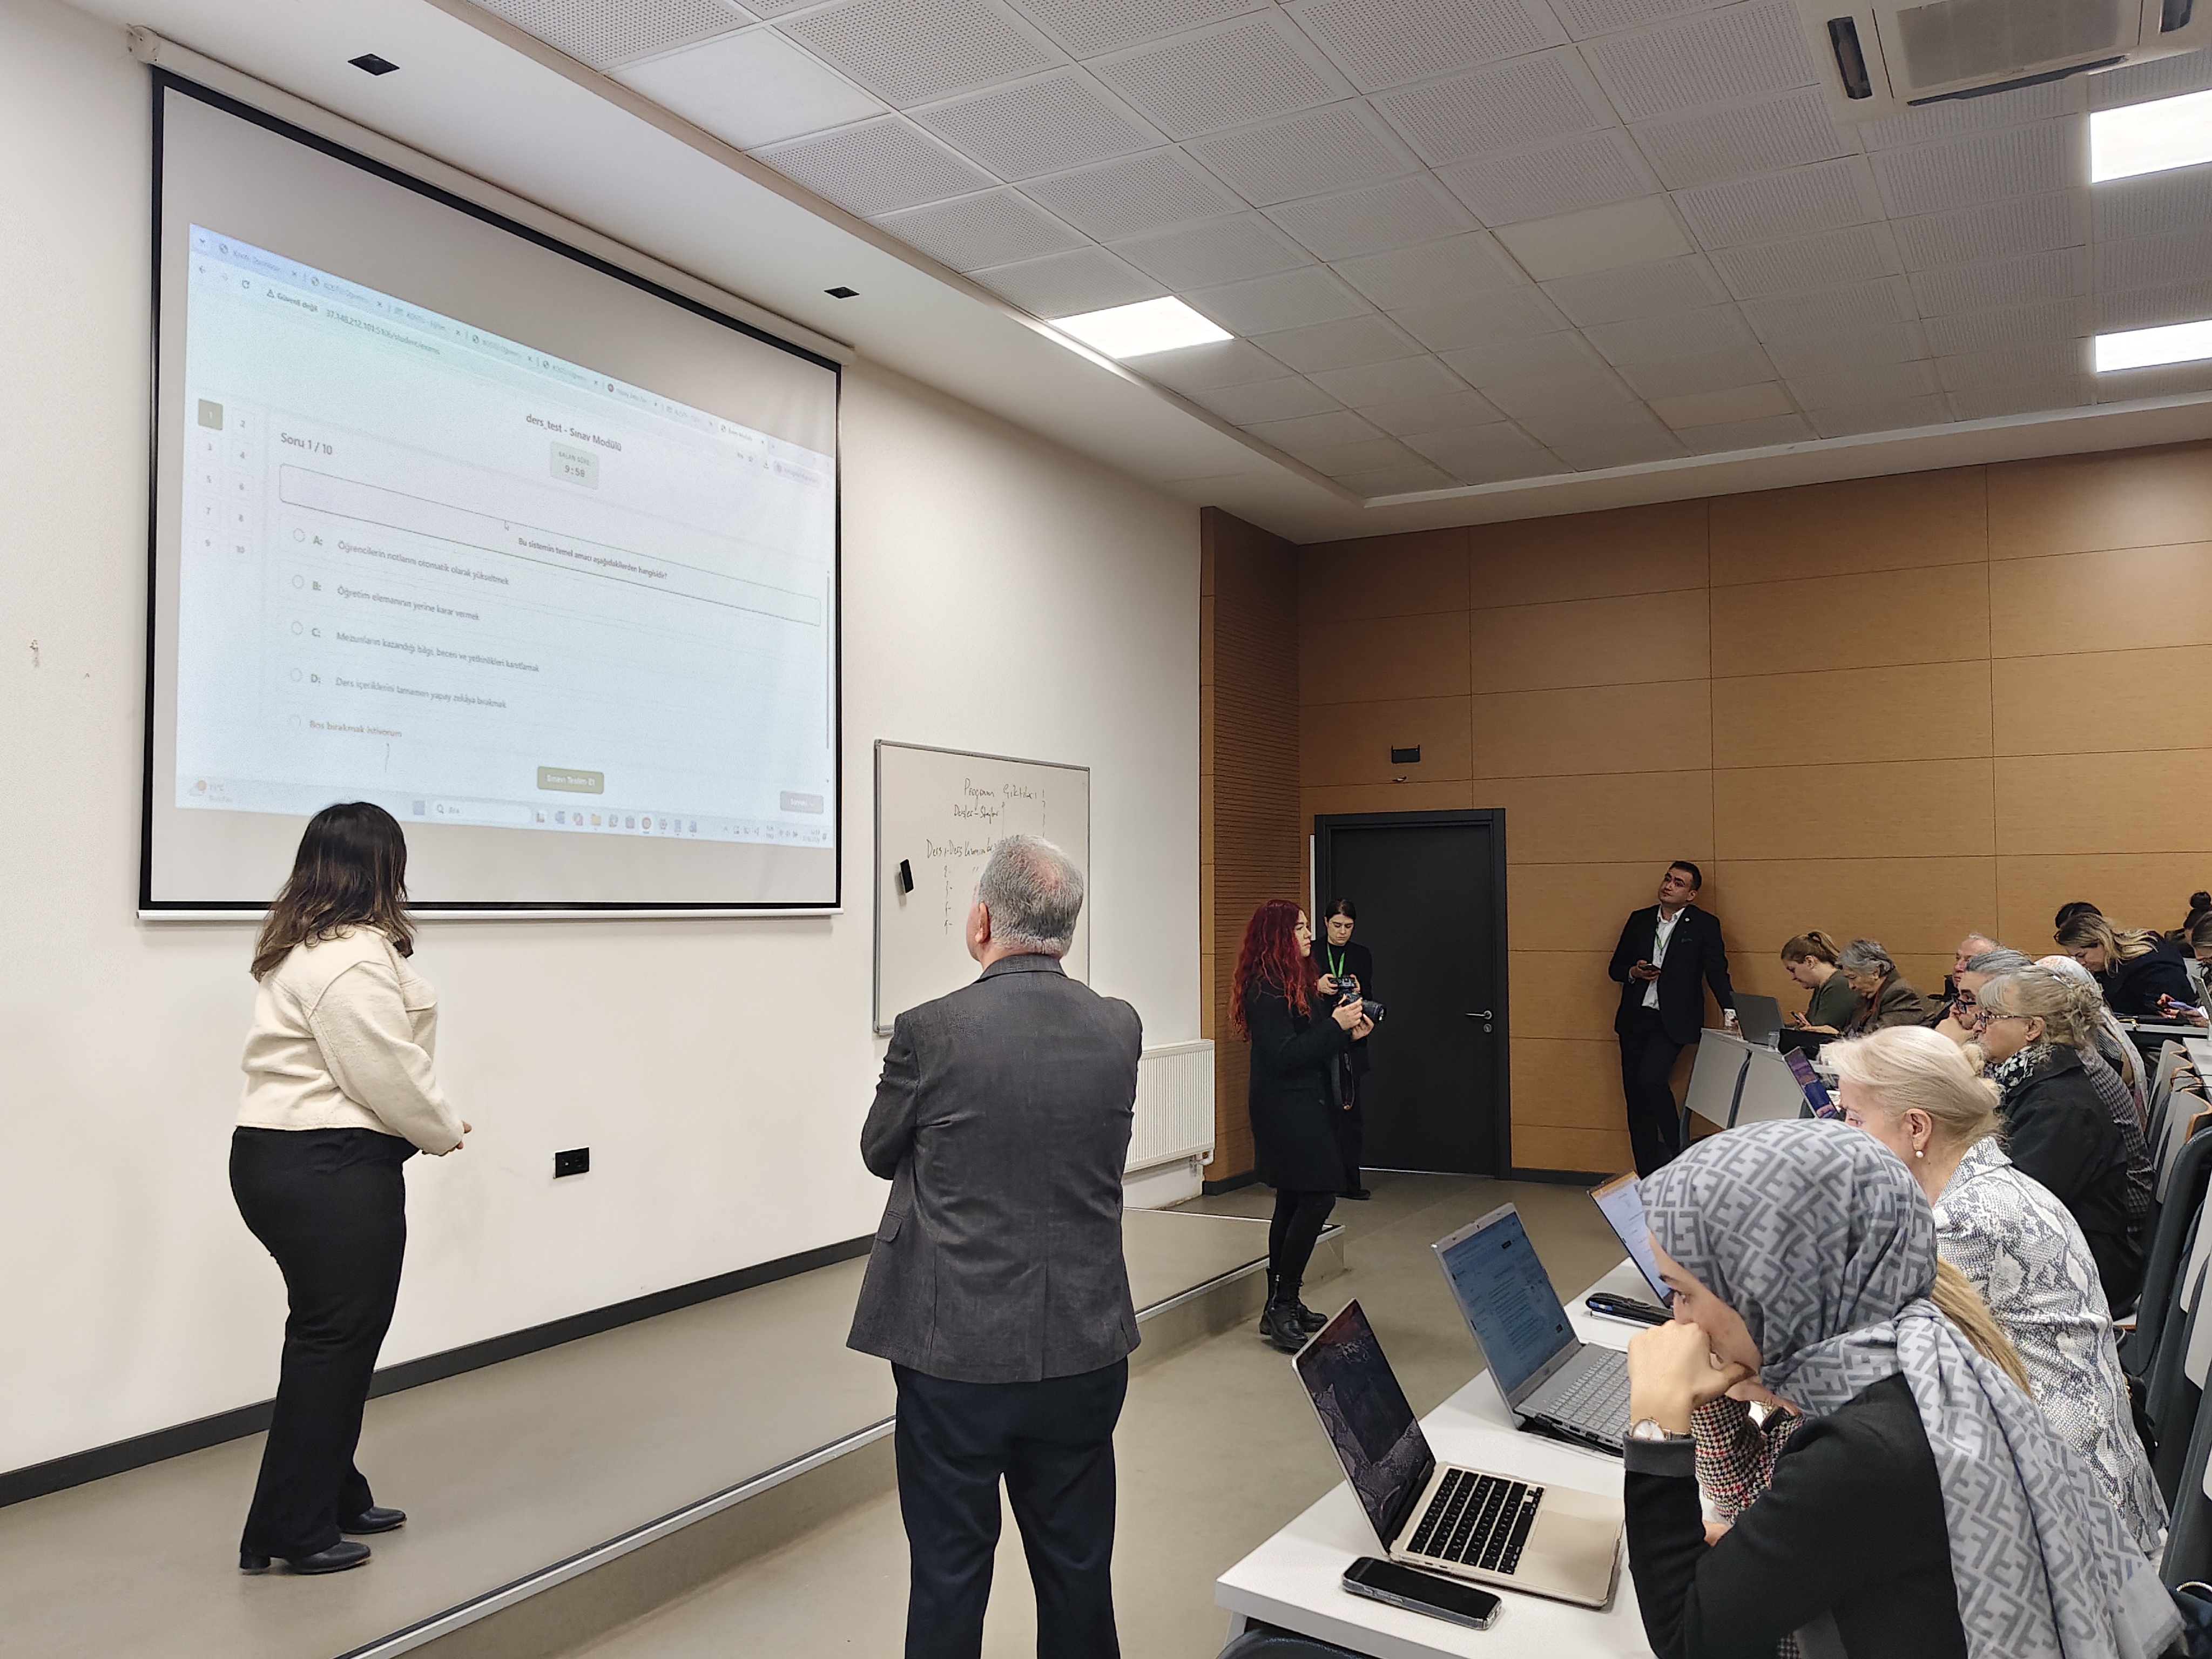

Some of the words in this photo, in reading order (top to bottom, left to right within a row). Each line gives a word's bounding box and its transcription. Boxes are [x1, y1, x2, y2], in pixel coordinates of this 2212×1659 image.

[526, 414, 562, 433] ders_test
[570, 428, 590, 441] Sınav
[592, 435, 622, 451] Modülü
[281, 432, 305, 448] Soru
[308, 440, 312, 450] 1
[315, 442, 320, 453] /
[323, 444, 333, 455] 10
[518, 537, 527, 547] Bu
[529, 541, 555, 553] sistemin
[556, 547, 573, 557] temel
[313, 535, 323, 545] A:
[338, 540, 386, 558] Öğrencilerin
[418, 559, 449, 572] otomatik
[451, 566, 471, 577] olarak
[473, 571, 509, 585] yükseltmek
[337, 585, 370, 599] Öğretim
[311, 673, 321, 684] D:
[335, 677, 355, 688] Ders
